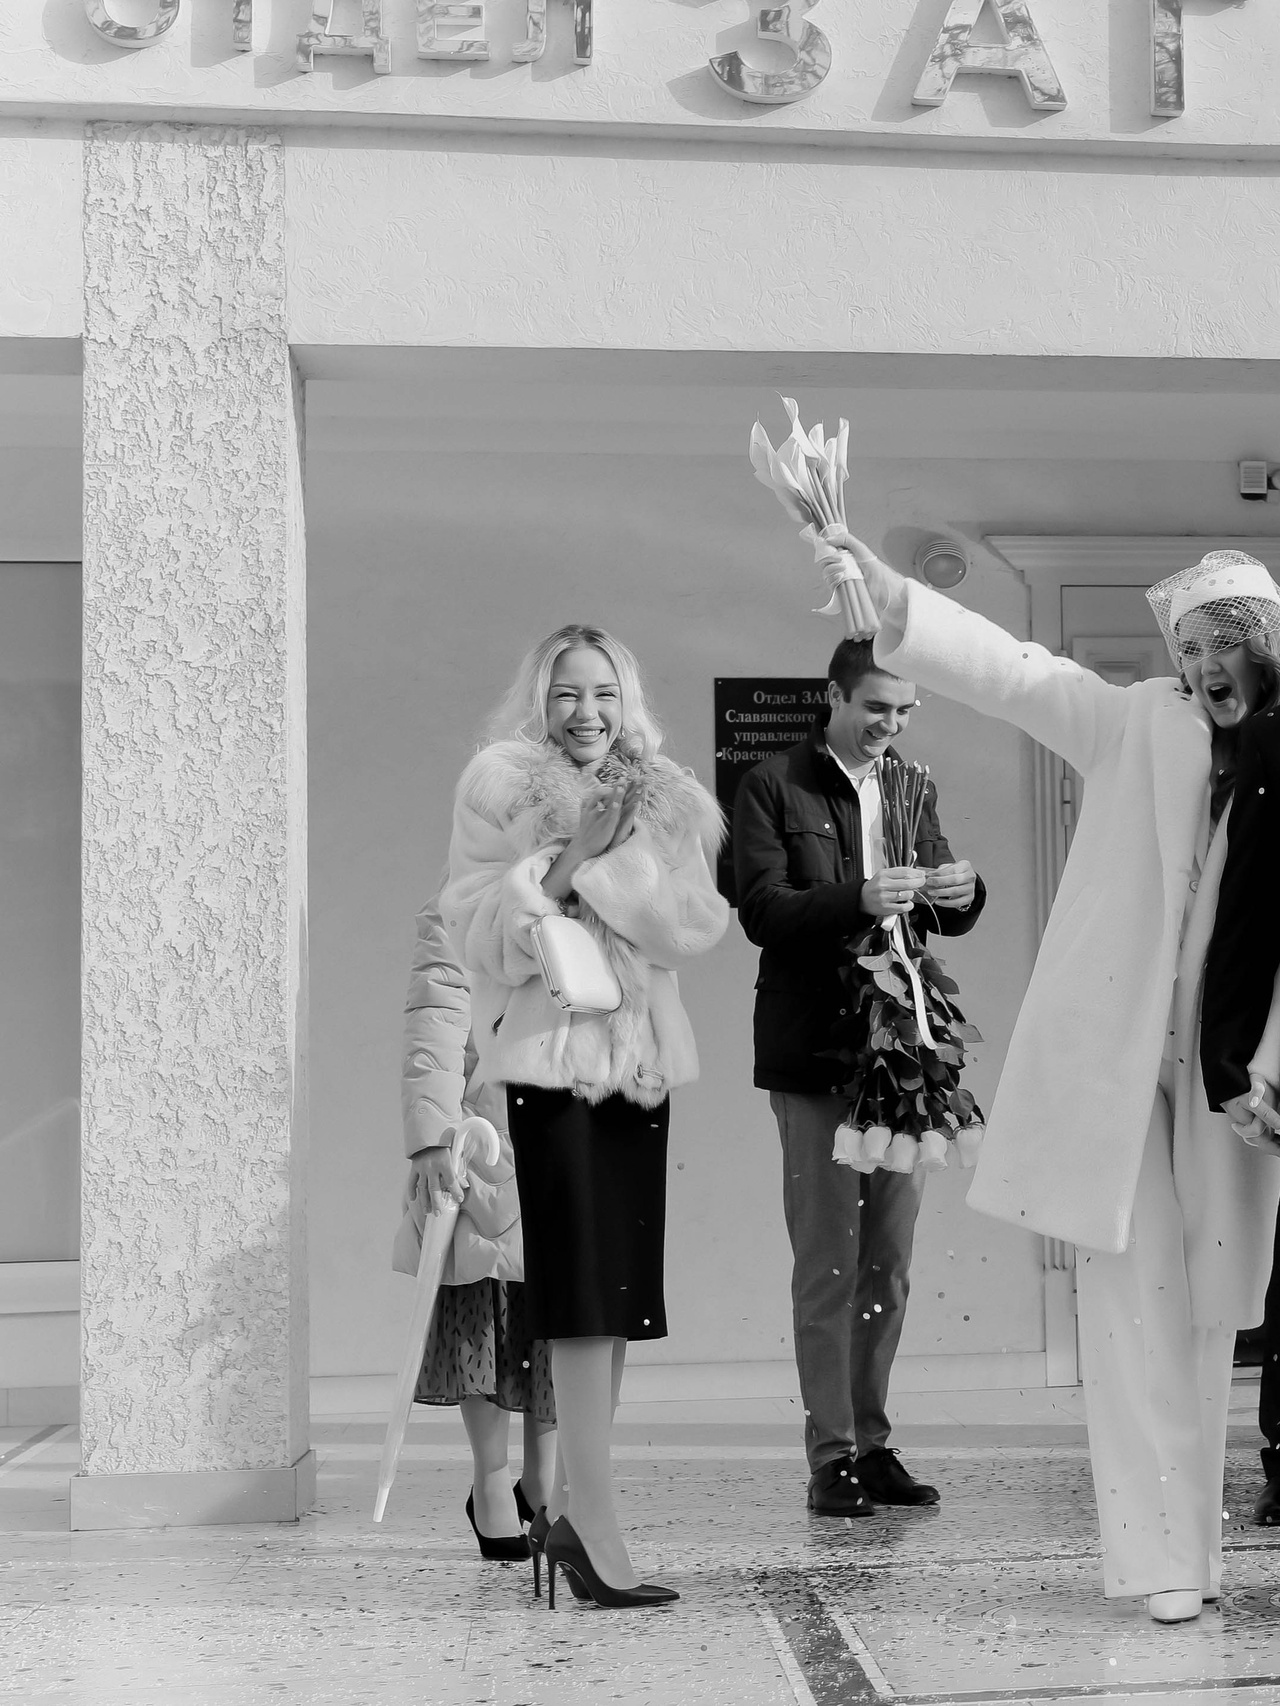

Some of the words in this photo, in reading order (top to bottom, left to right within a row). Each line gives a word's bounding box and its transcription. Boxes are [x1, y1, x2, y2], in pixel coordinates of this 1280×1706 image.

[753, 690, 796, 705] Отдел
[725, 709, 816, 723] Славянского
[721, 747, 784, 764] Красно
